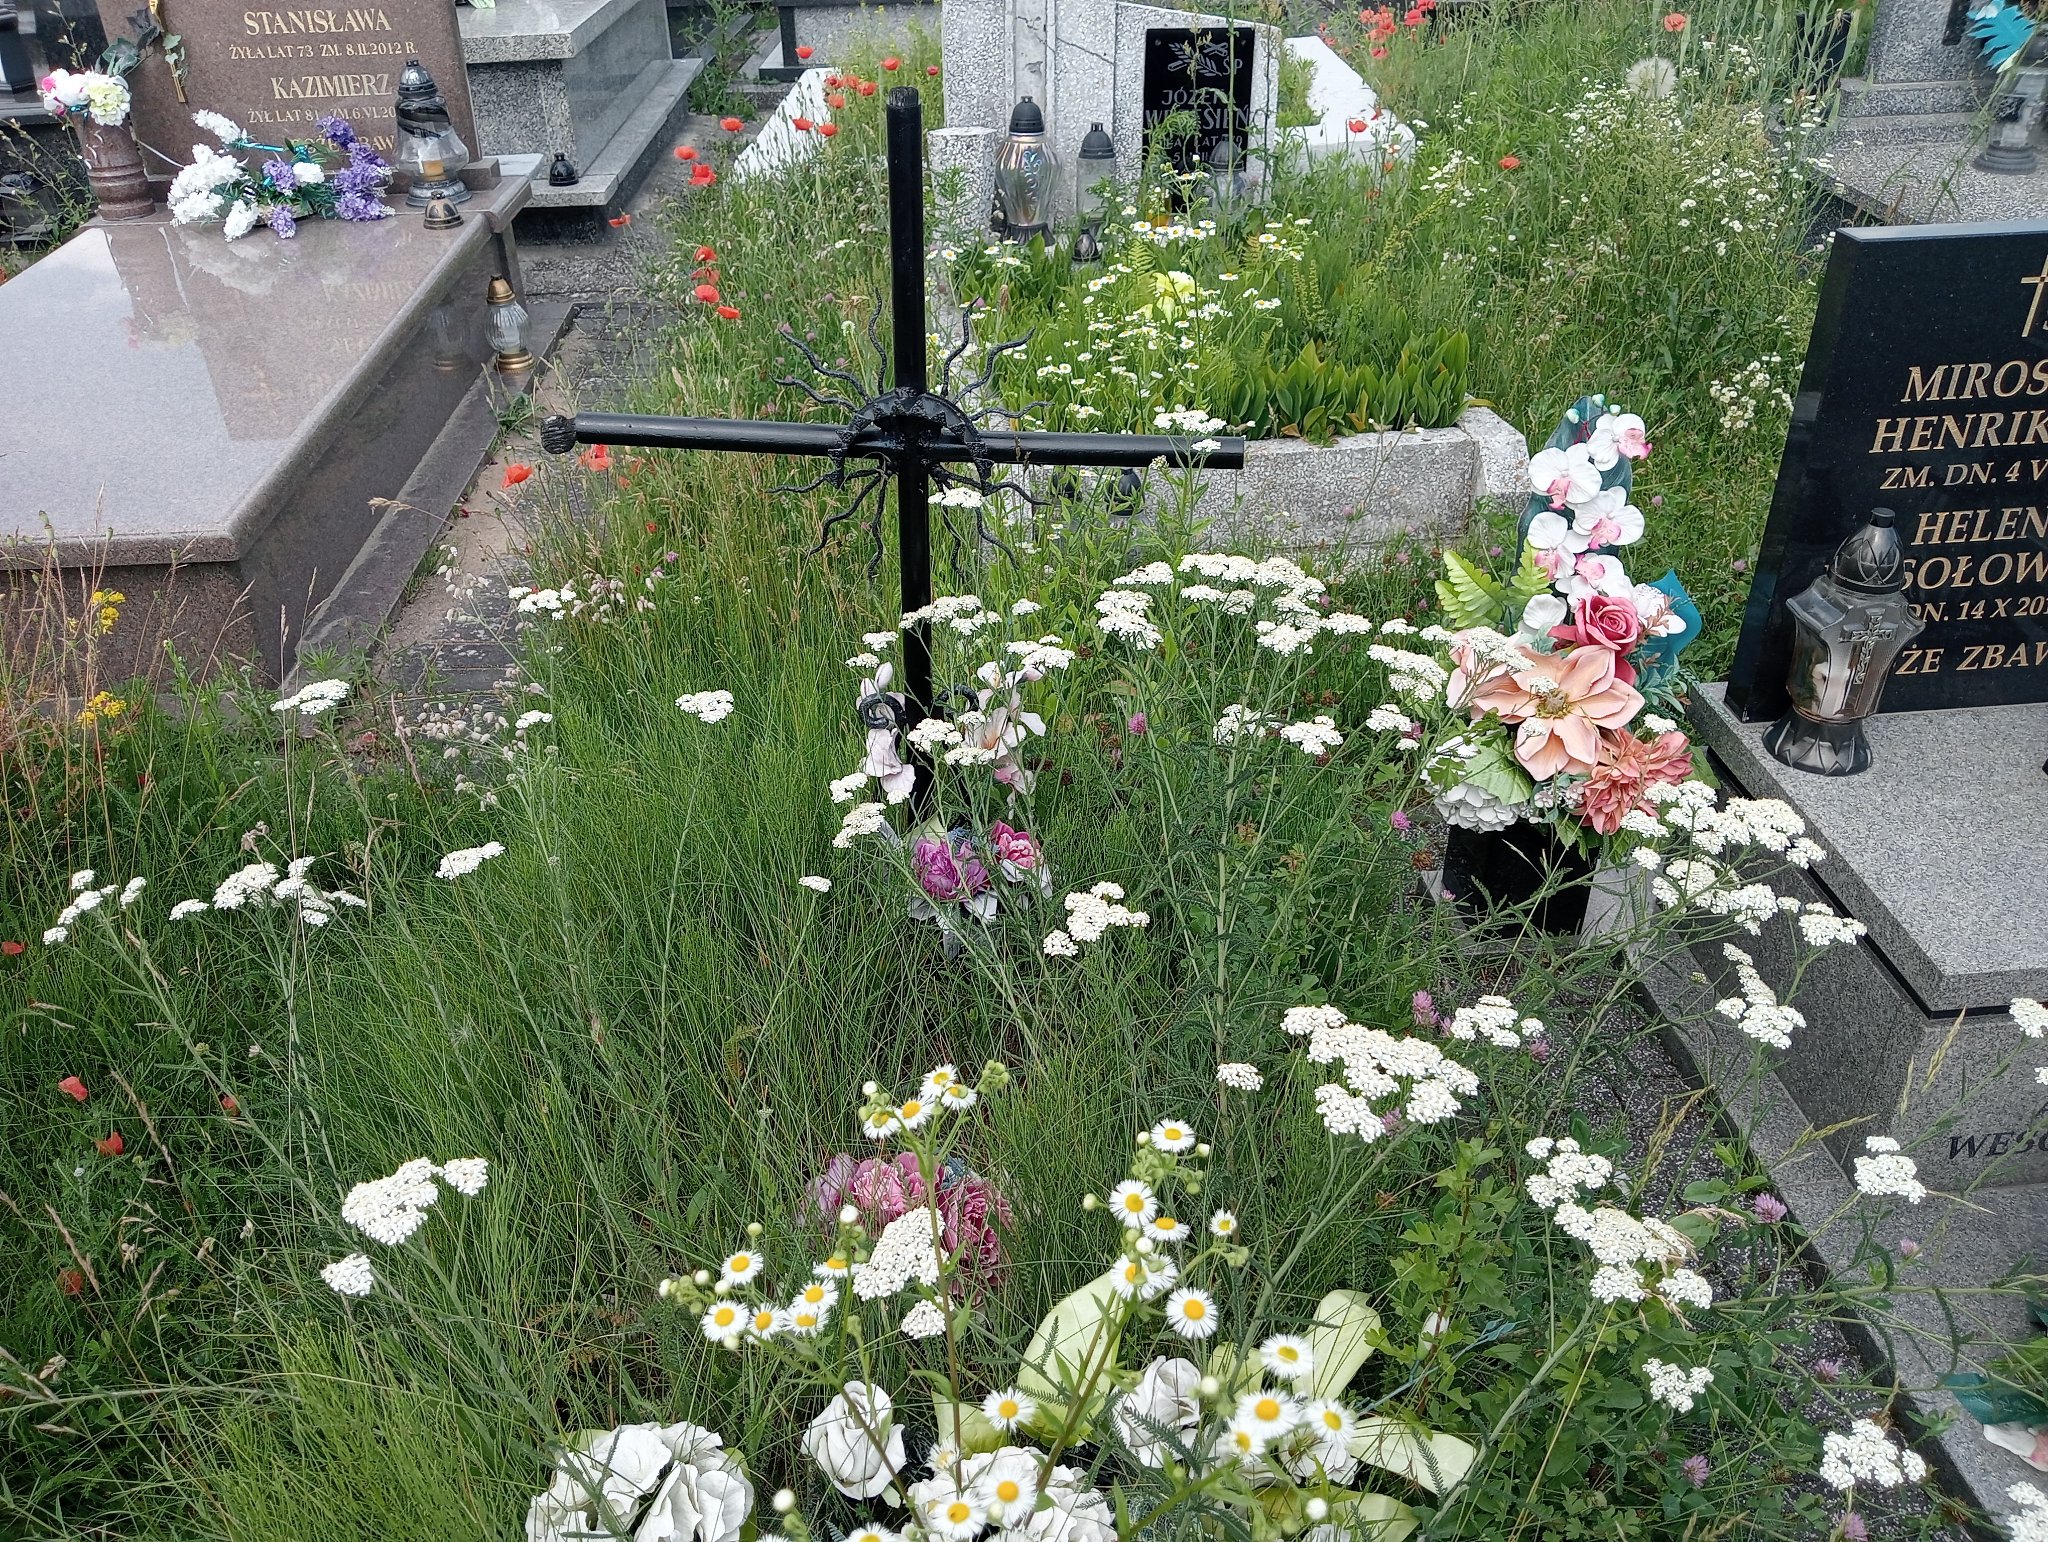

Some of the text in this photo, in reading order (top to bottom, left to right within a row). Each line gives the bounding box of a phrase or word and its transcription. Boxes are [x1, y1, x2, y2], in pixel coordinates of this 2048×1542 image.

[243, 8, 392, 36] STANISŁAWA
[229, 44, 266, 60] ŻYŁA
[268, 45, 294, 59] LAT
[298, 45, 314, 58] 73
[319, 43, 343, 57] ZM.
[405, 41, 419, 54] R.
[271, 73, 393, 99] KAZIMIERZ
[248, 108, 274, 123] ŻYŁ
[277, 110, 301, 122] LAT
[305, 109, 319, 121] 81
[353, 105, 397, 119] 6.VI.20
[1901, 358, 2048, 402] MIROS
[1869, 409, 2048, 453] HENRIK
[1880, 464, 1935, 490] ZM.
[1943, 462, 1997, 486] DN.
[2004, 460, 2022, 482] 4
[1911, 506, 2048, 546] HELEN
[1957, 600, 1985, 620] 14
[1989, 597, 2012, 618] X
